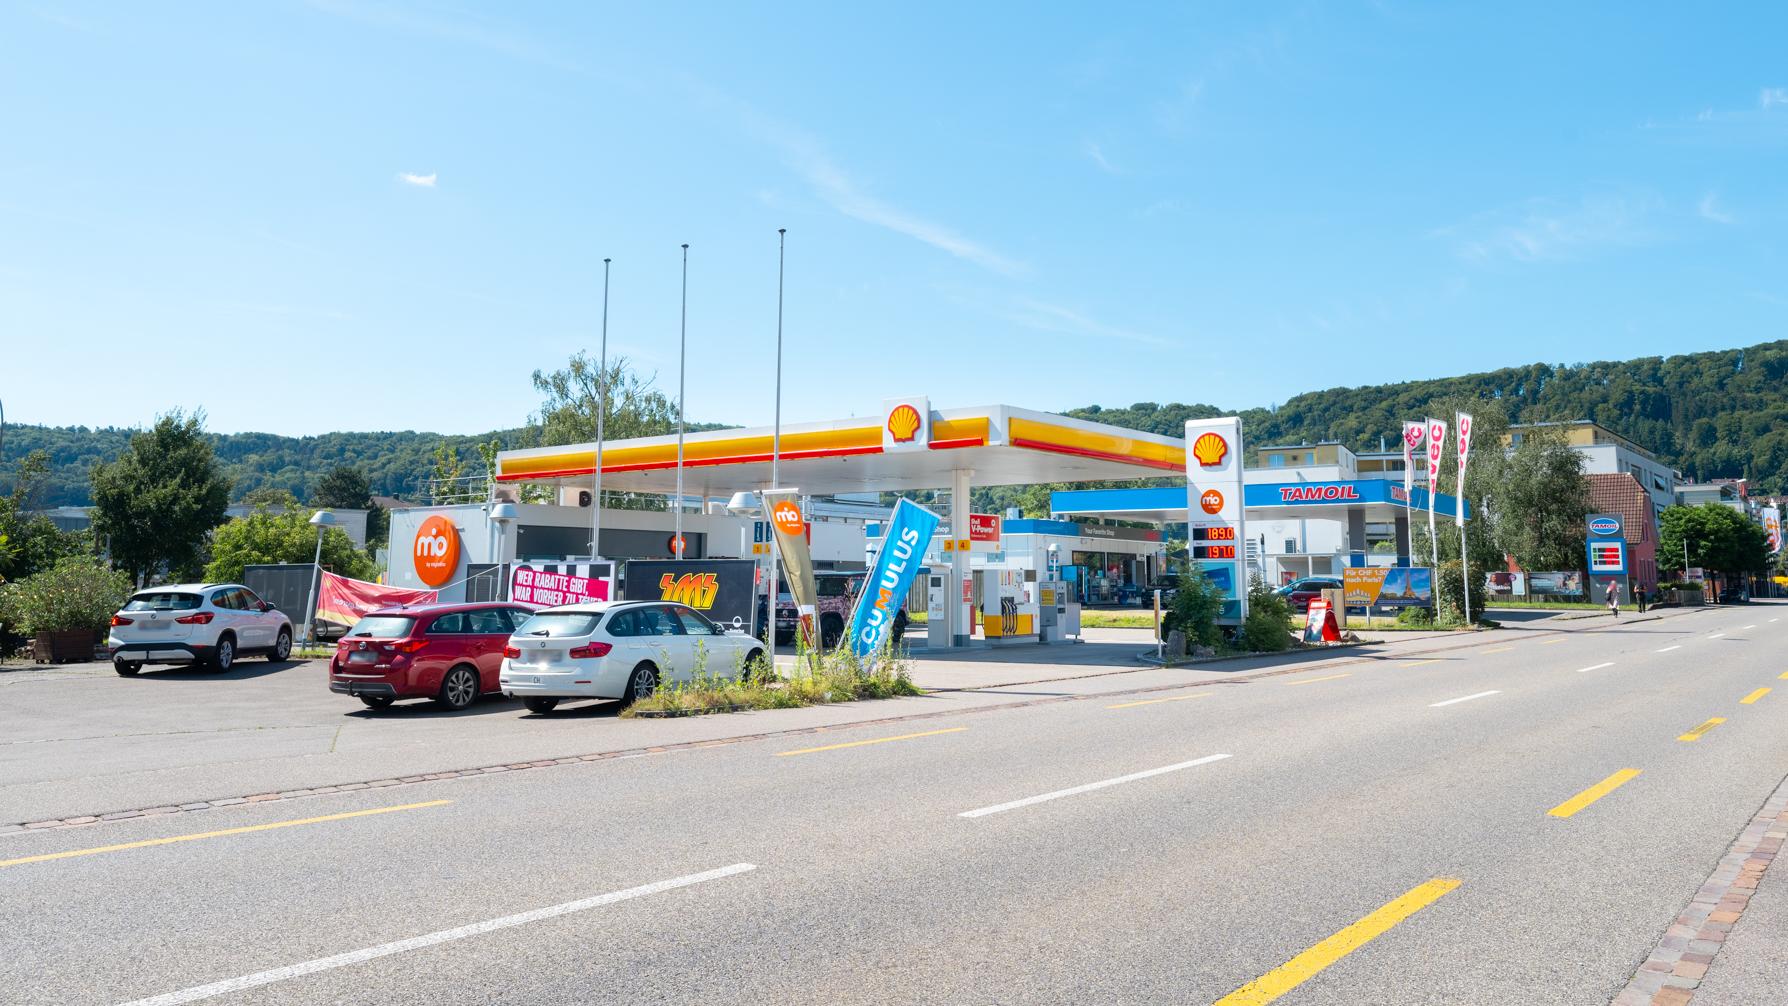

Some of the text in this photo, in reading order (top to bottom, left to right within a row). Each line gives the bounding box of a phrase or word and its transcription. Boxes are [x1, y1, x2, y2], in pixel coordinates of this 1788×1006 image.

[1202, 493, 1220, 505] mio
[1280, 485, 1360, 501] TAMOIL
[776, 507, 799, 522] mio
[416, 527, 447, 557] mio
[1208, 528, 1234, 540] 189.0
[960, 541, 965, 549] 4
[516, 570, 589, 596] WER RABATTE GIBT,
[660, 573, 719, 610] SMS
[861, 527, 918, 644] CUMULUS
[514, 585, 531, 601] WAR
[534, 588, 563, 606] VORHER
